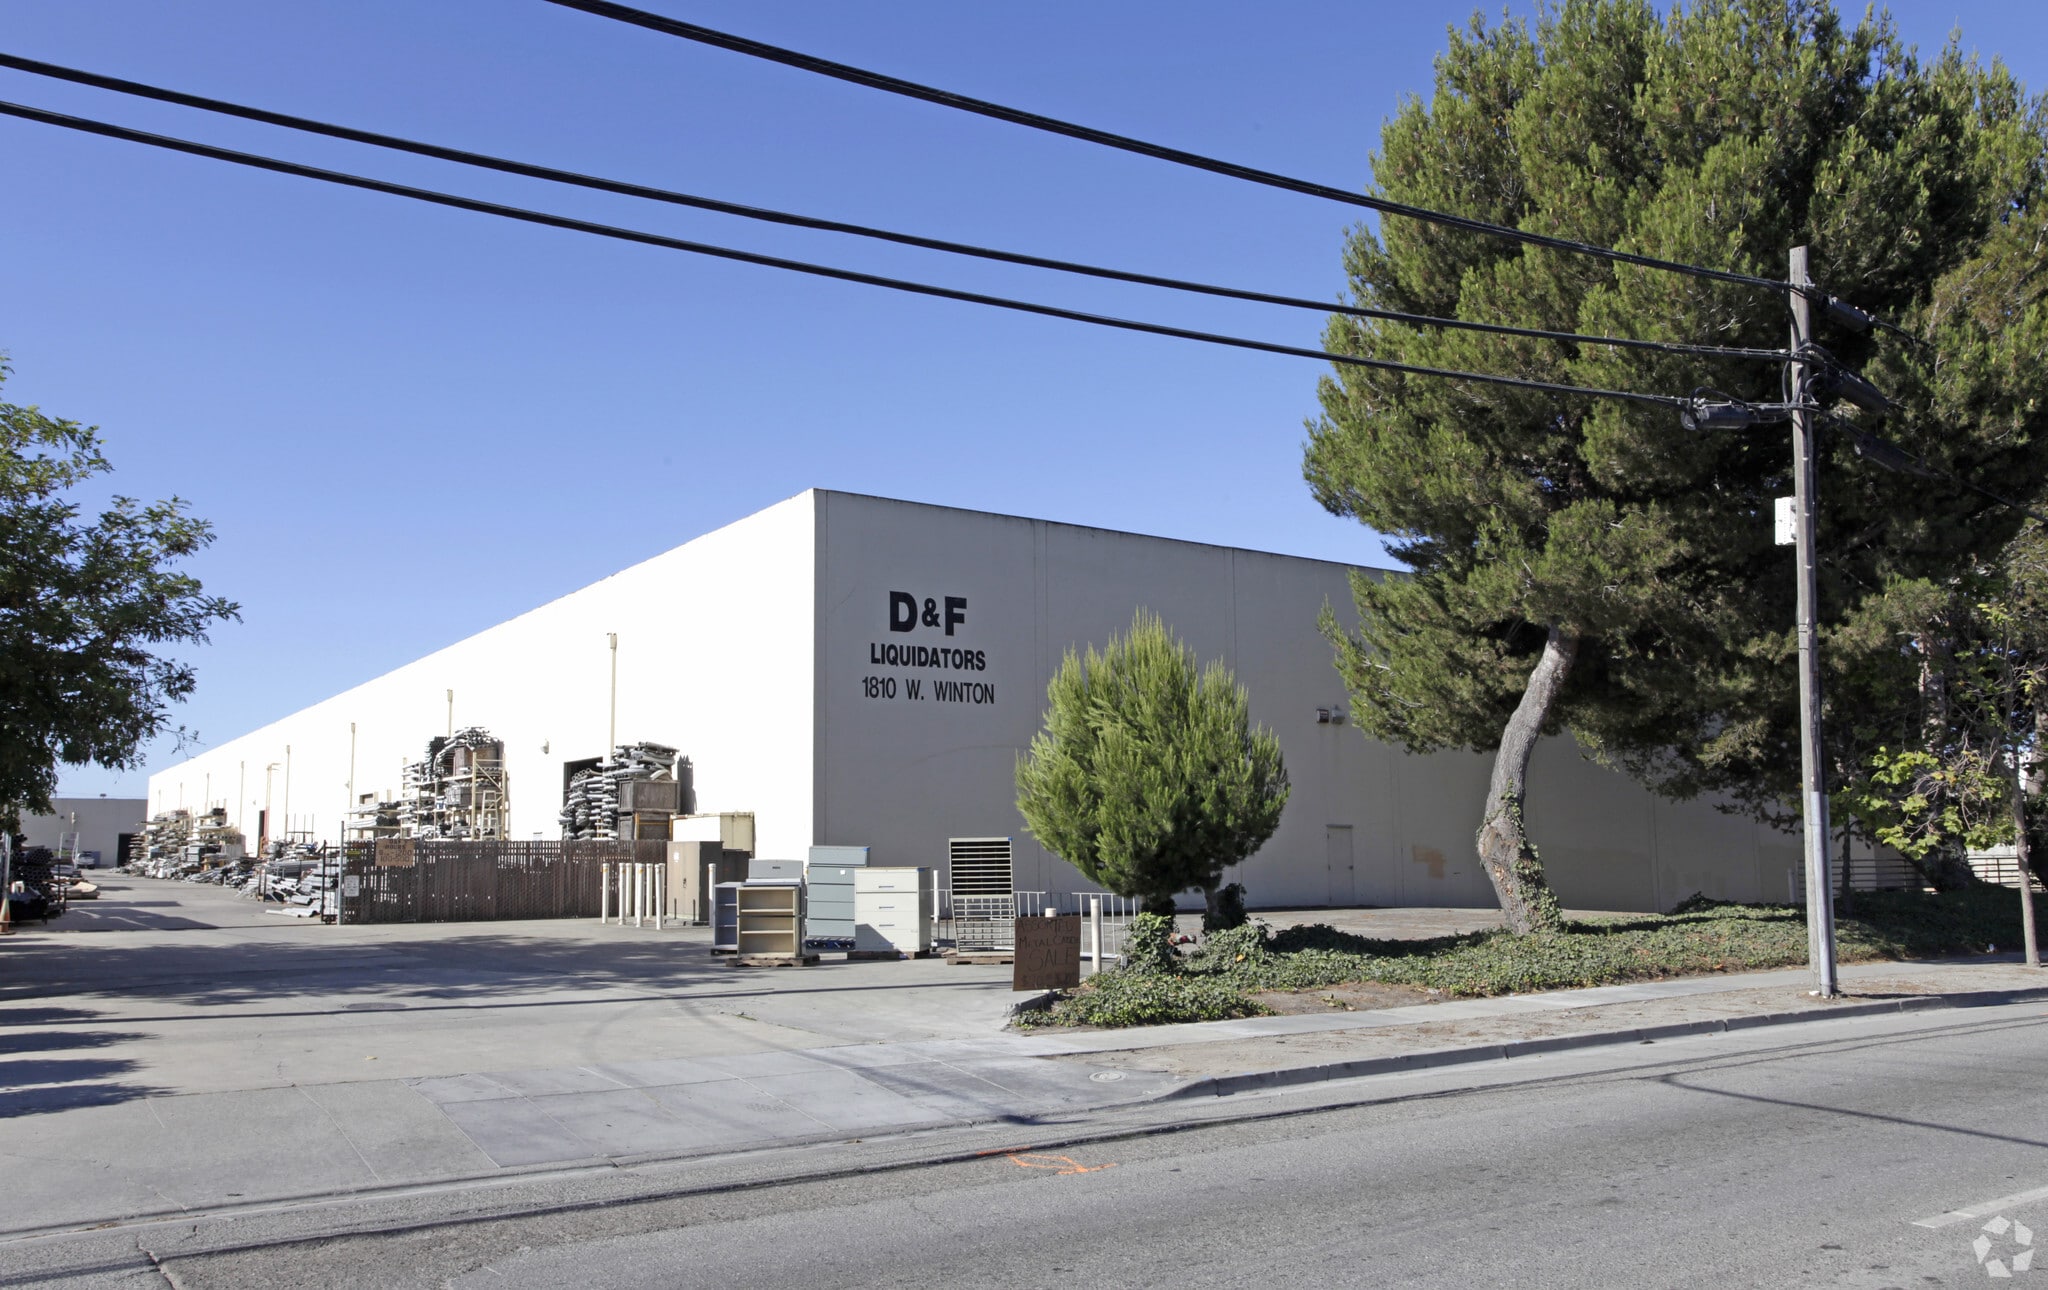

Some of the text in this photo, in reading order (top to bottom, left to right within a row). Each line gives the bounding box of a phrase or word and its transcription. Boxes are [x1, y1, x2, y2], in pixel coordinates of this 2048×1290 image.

[870, 642, 986, 671] LIQUIDATORS
[862, 676, 995, 704] 1810 W. WINTON
[1027, 948, 1074, 972] SALE
